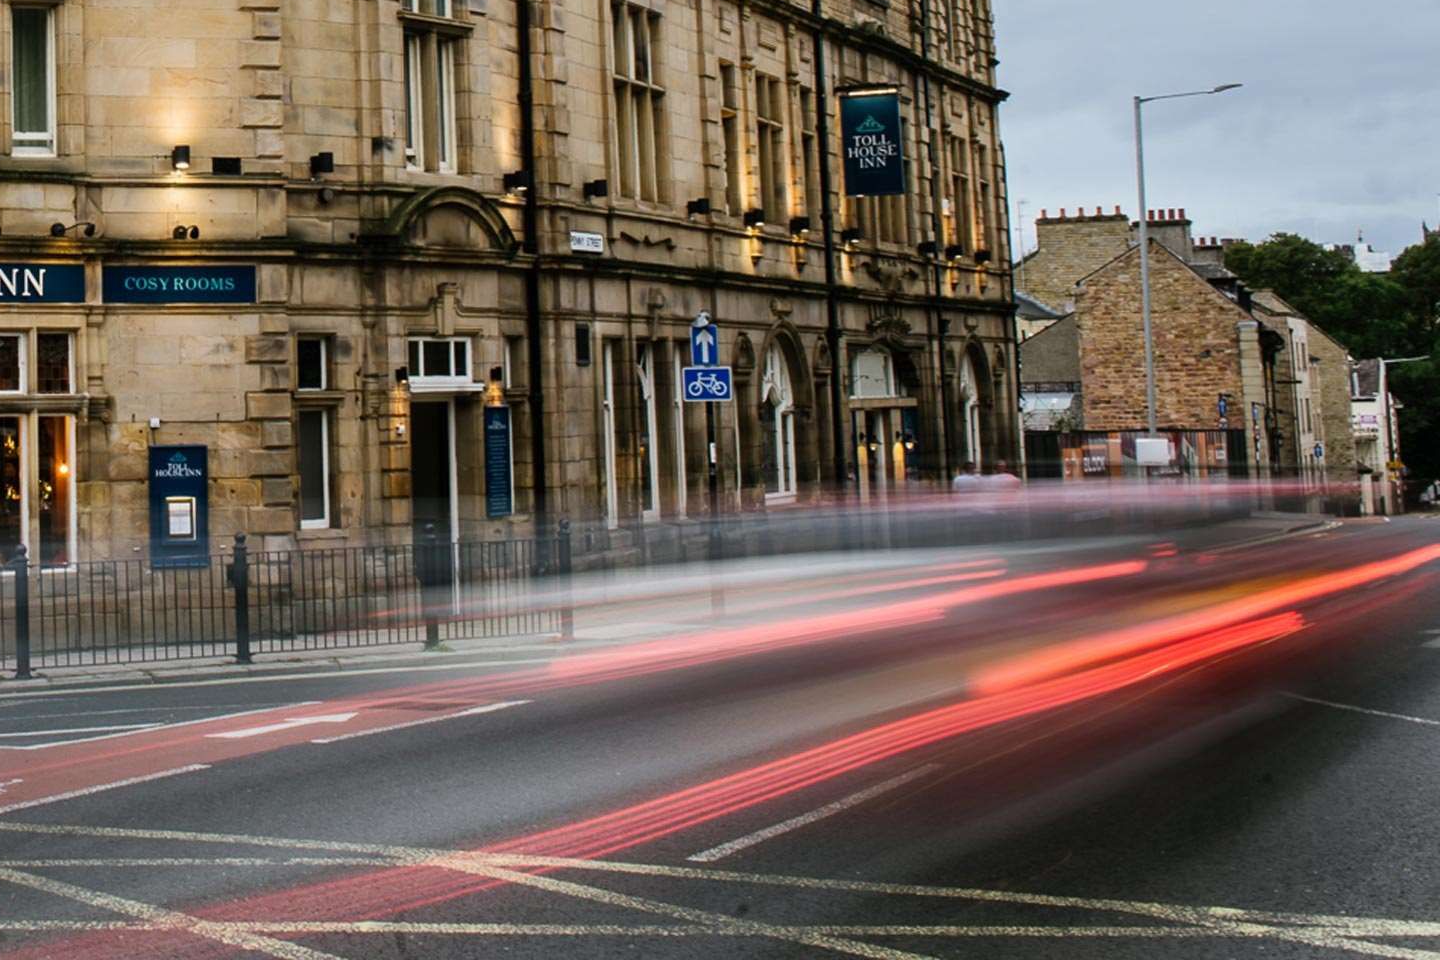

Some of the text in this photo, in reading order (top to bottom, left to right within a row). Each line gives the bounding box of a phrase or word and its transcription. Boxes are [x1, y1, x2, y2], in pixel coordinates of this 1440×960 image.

[852, 134, 892, 147] TOLL
[848, 144, 898, 158] HOUSE
[860, 157, 886, 169] INN
[124, 276, 235, 291] COSY ROOMS
